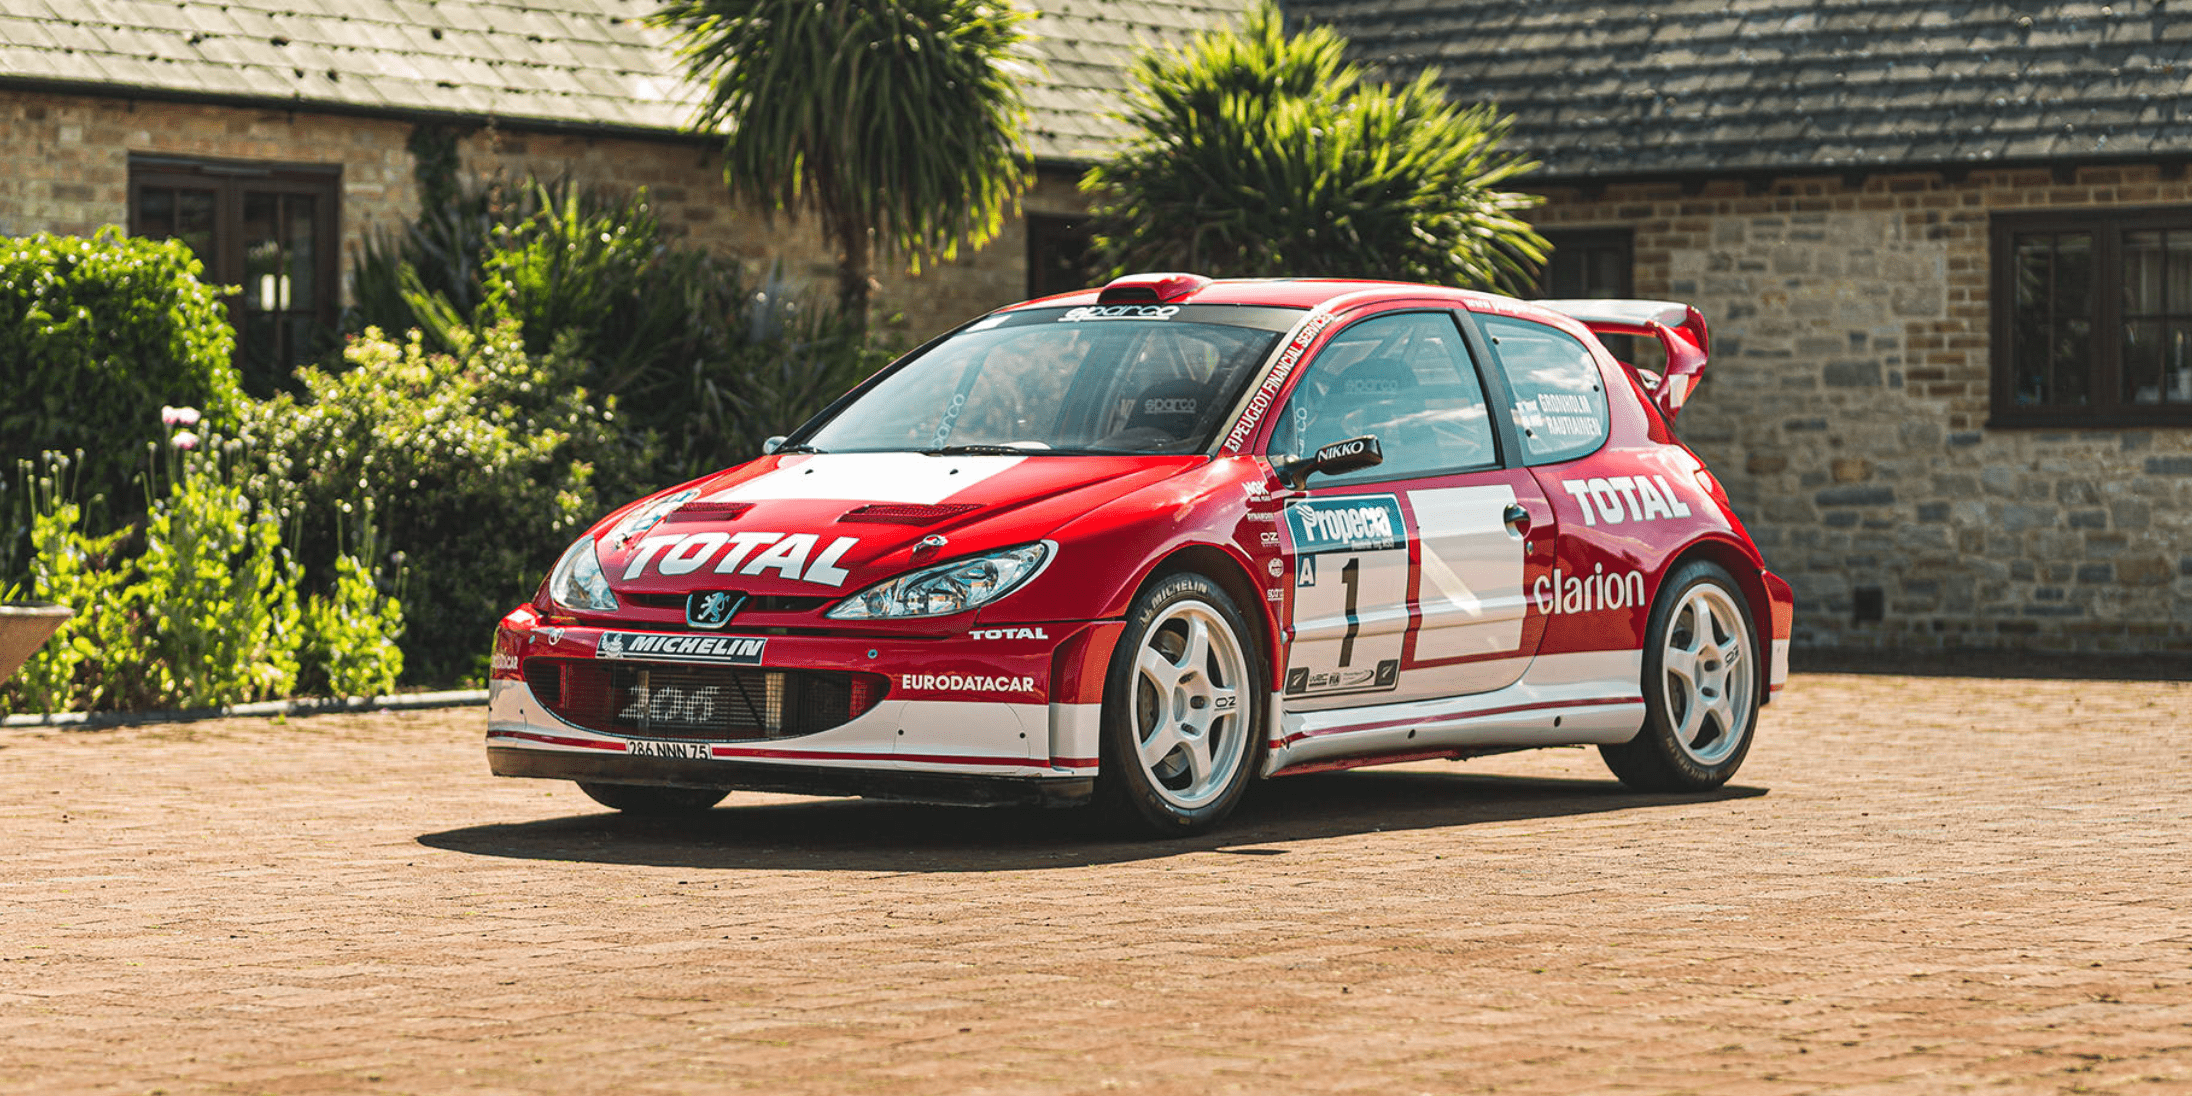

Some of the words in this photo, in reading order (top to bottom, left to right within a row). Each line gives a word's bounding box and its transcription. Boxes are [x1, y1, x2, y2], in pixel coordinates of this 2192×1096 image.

[1058, 305, 1180, 322] sparco
[1144, 398, 1197, 414] sparco
[1230, 388, 1272, 444] PEUGEOT
[1261, 345, 1304, 394] FINANCIAL
[1318, 441, 1364, 462] NIKKO
[1562, 475, 1692, 527] TOTAL
[622, 531, 860, 588] TOTAL
[1299, 557, 1315, 585] A
[1151, 580, 1208, 608] MICHELIN
[1533, 562, 1646, 615] clarion
[1338, 557, 1359, 668] 1
[968, 627, 1049, 640] TOTAL
[628, 636, 763, 656] MICHELIN
[902, 674, 1034, 692] EURODATACAR
[618, 685, 720, 723] 206
[1215, 696, 1236, 708] OZ
[629, 741, 654, 757] 286
[657, 743, 687, 758] NNN
[690, 745, 708, 759] 75
